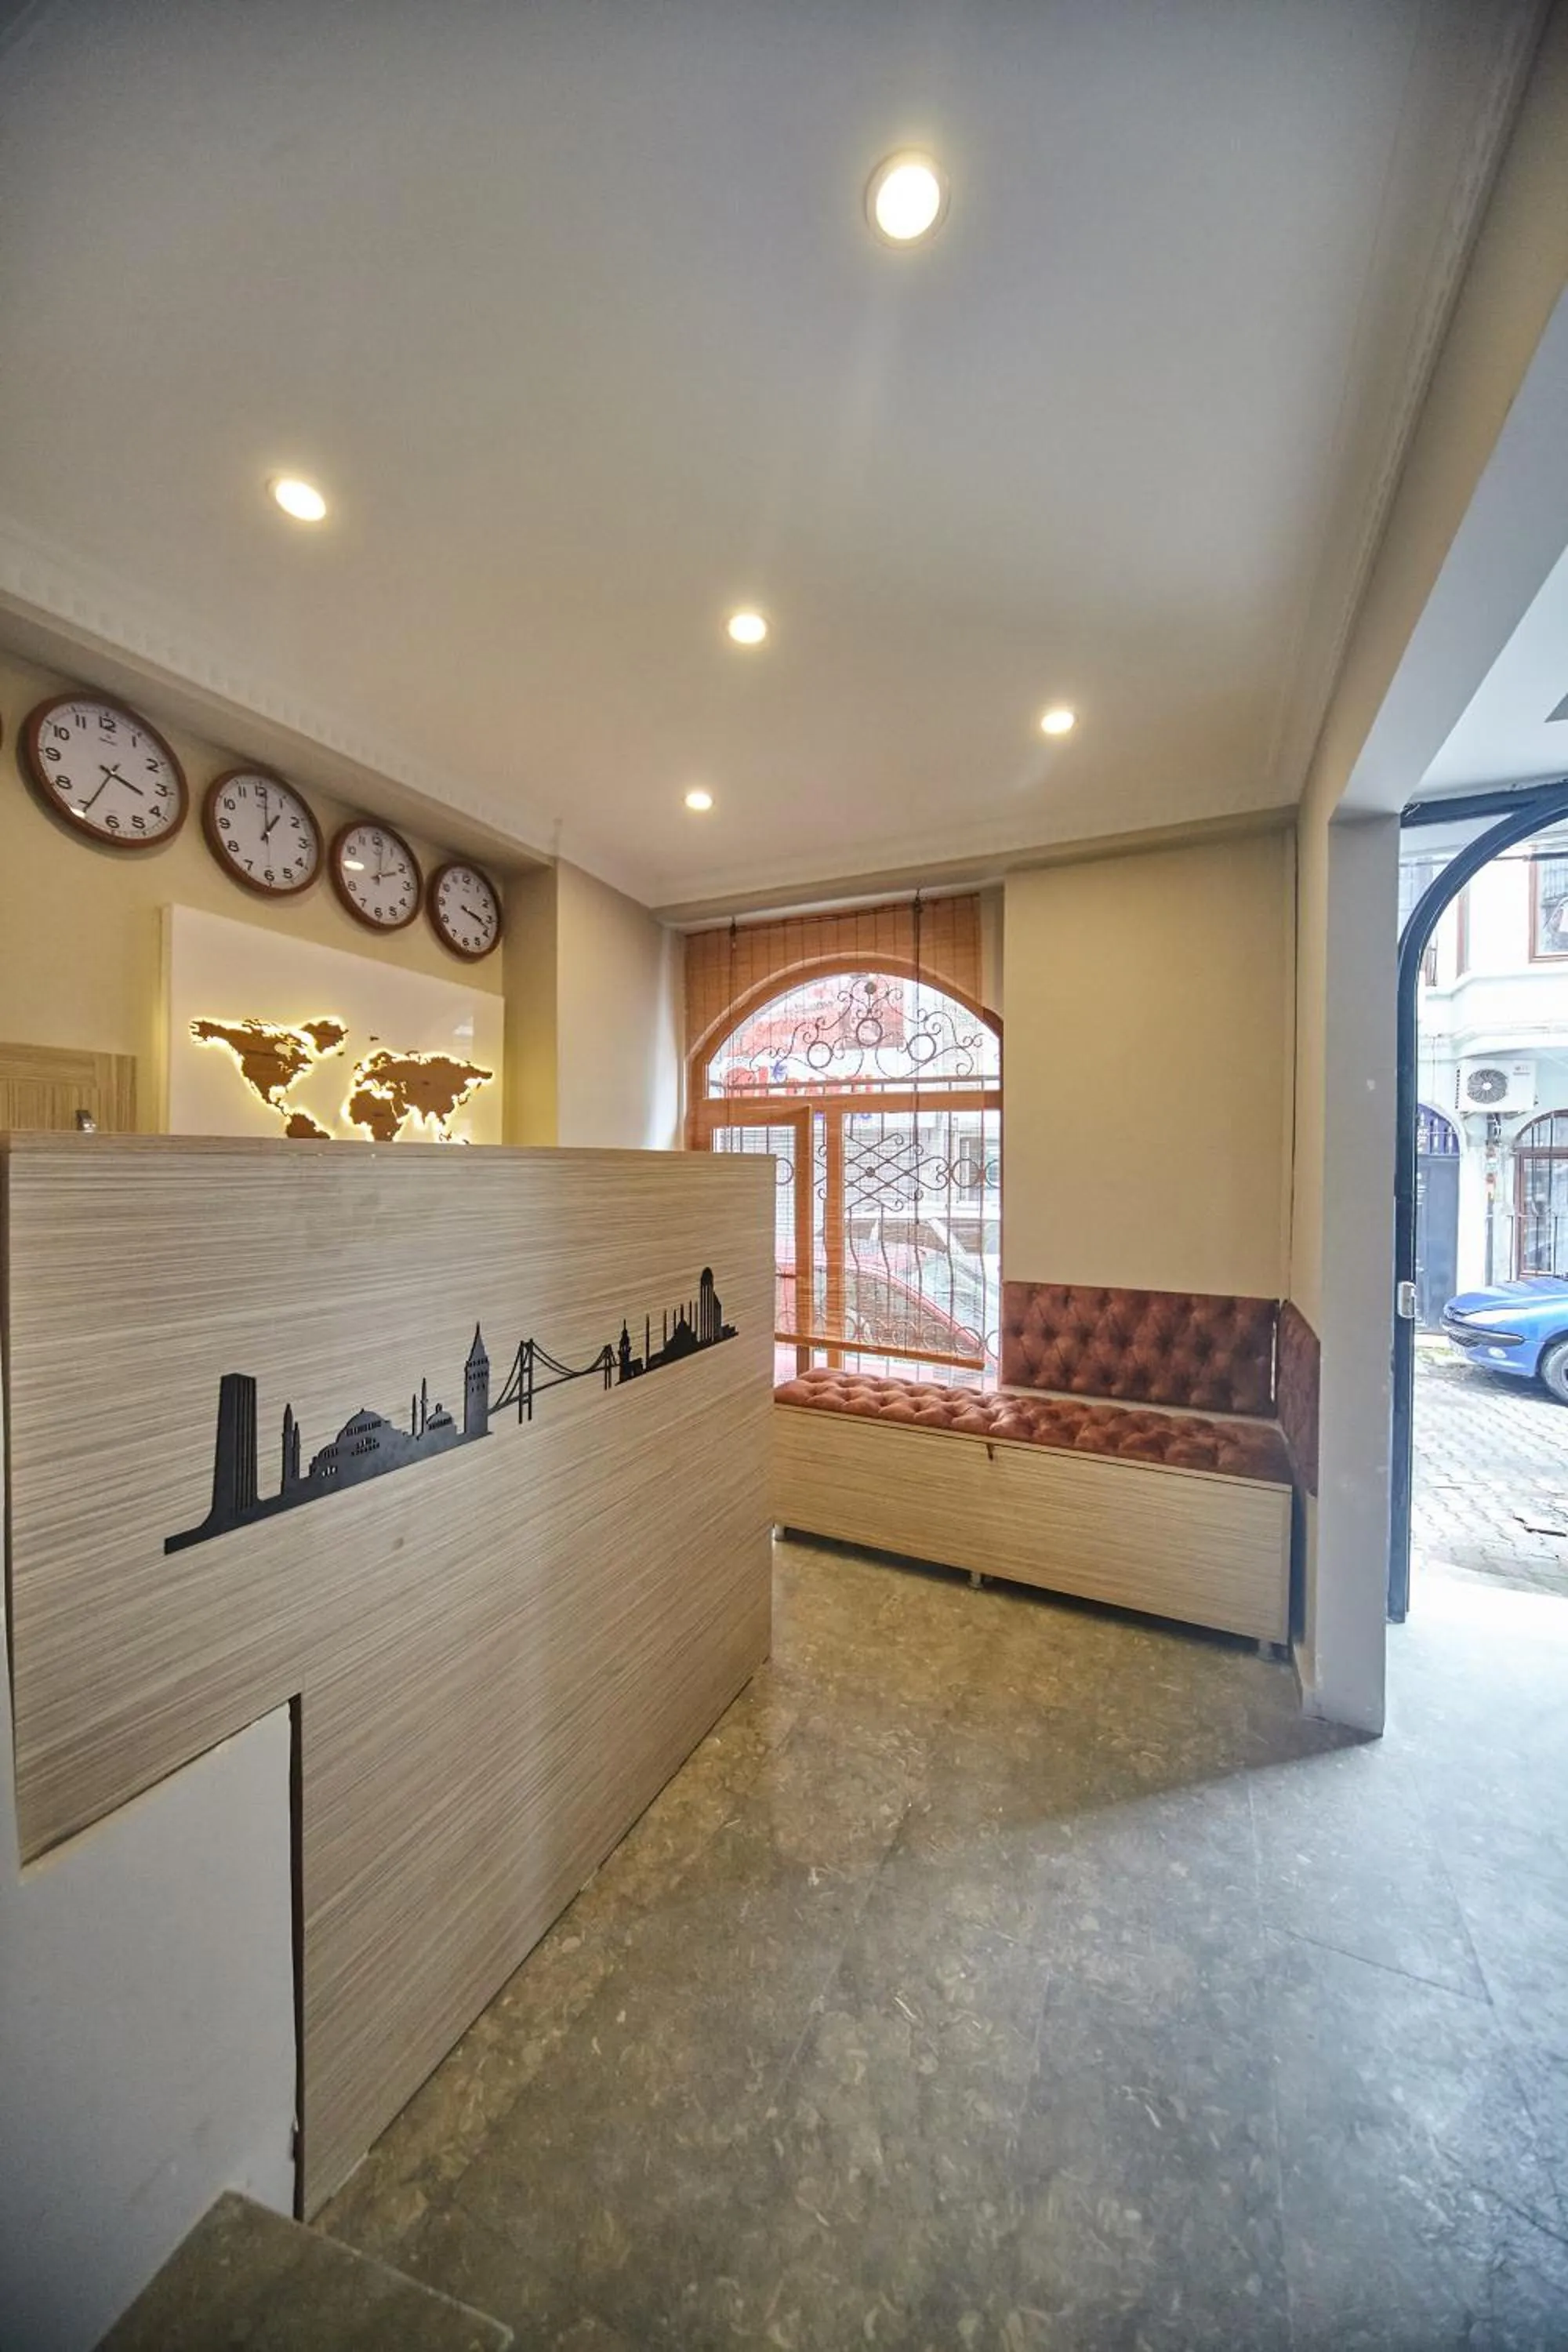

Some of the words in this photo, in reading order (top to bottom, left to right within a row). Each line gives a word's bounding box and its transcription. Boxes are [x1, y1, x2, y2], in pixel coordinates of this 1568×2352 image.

[75, 714, 86, 729] 11
[100, 715, 116, 733] 12
[53, 725, 70, 740] 10
[132, 735, 136, 747] 1
[45, 747, 61, 761] 9
[146, 758, 159, 773] 2
[55, 775, 72, 789] 8
[154, 783, 168, 797] 3
[238, 786, 246, 798] 11
[223, 797, 235, 810] 10
[279, 798, 283, 809] 1
[149, 805, 162, 817] 4
[105, 815, 119, 829] 6
[131, 815, 146, 829] 5
[219, 817, 230, 829] 9
[290, 816, 299, 828] 2
[227, 840, 239, 852] 8
[298, 837, 307, 849] 3
[243, 858, 254, 871] 7
[295, 857, 303, 867] 4
[283, 868, 292, 879] 5
[397, 863, 406, 874] 2
[264, 869, 274, 881] 6
[359, 898, 367, 907] 7
